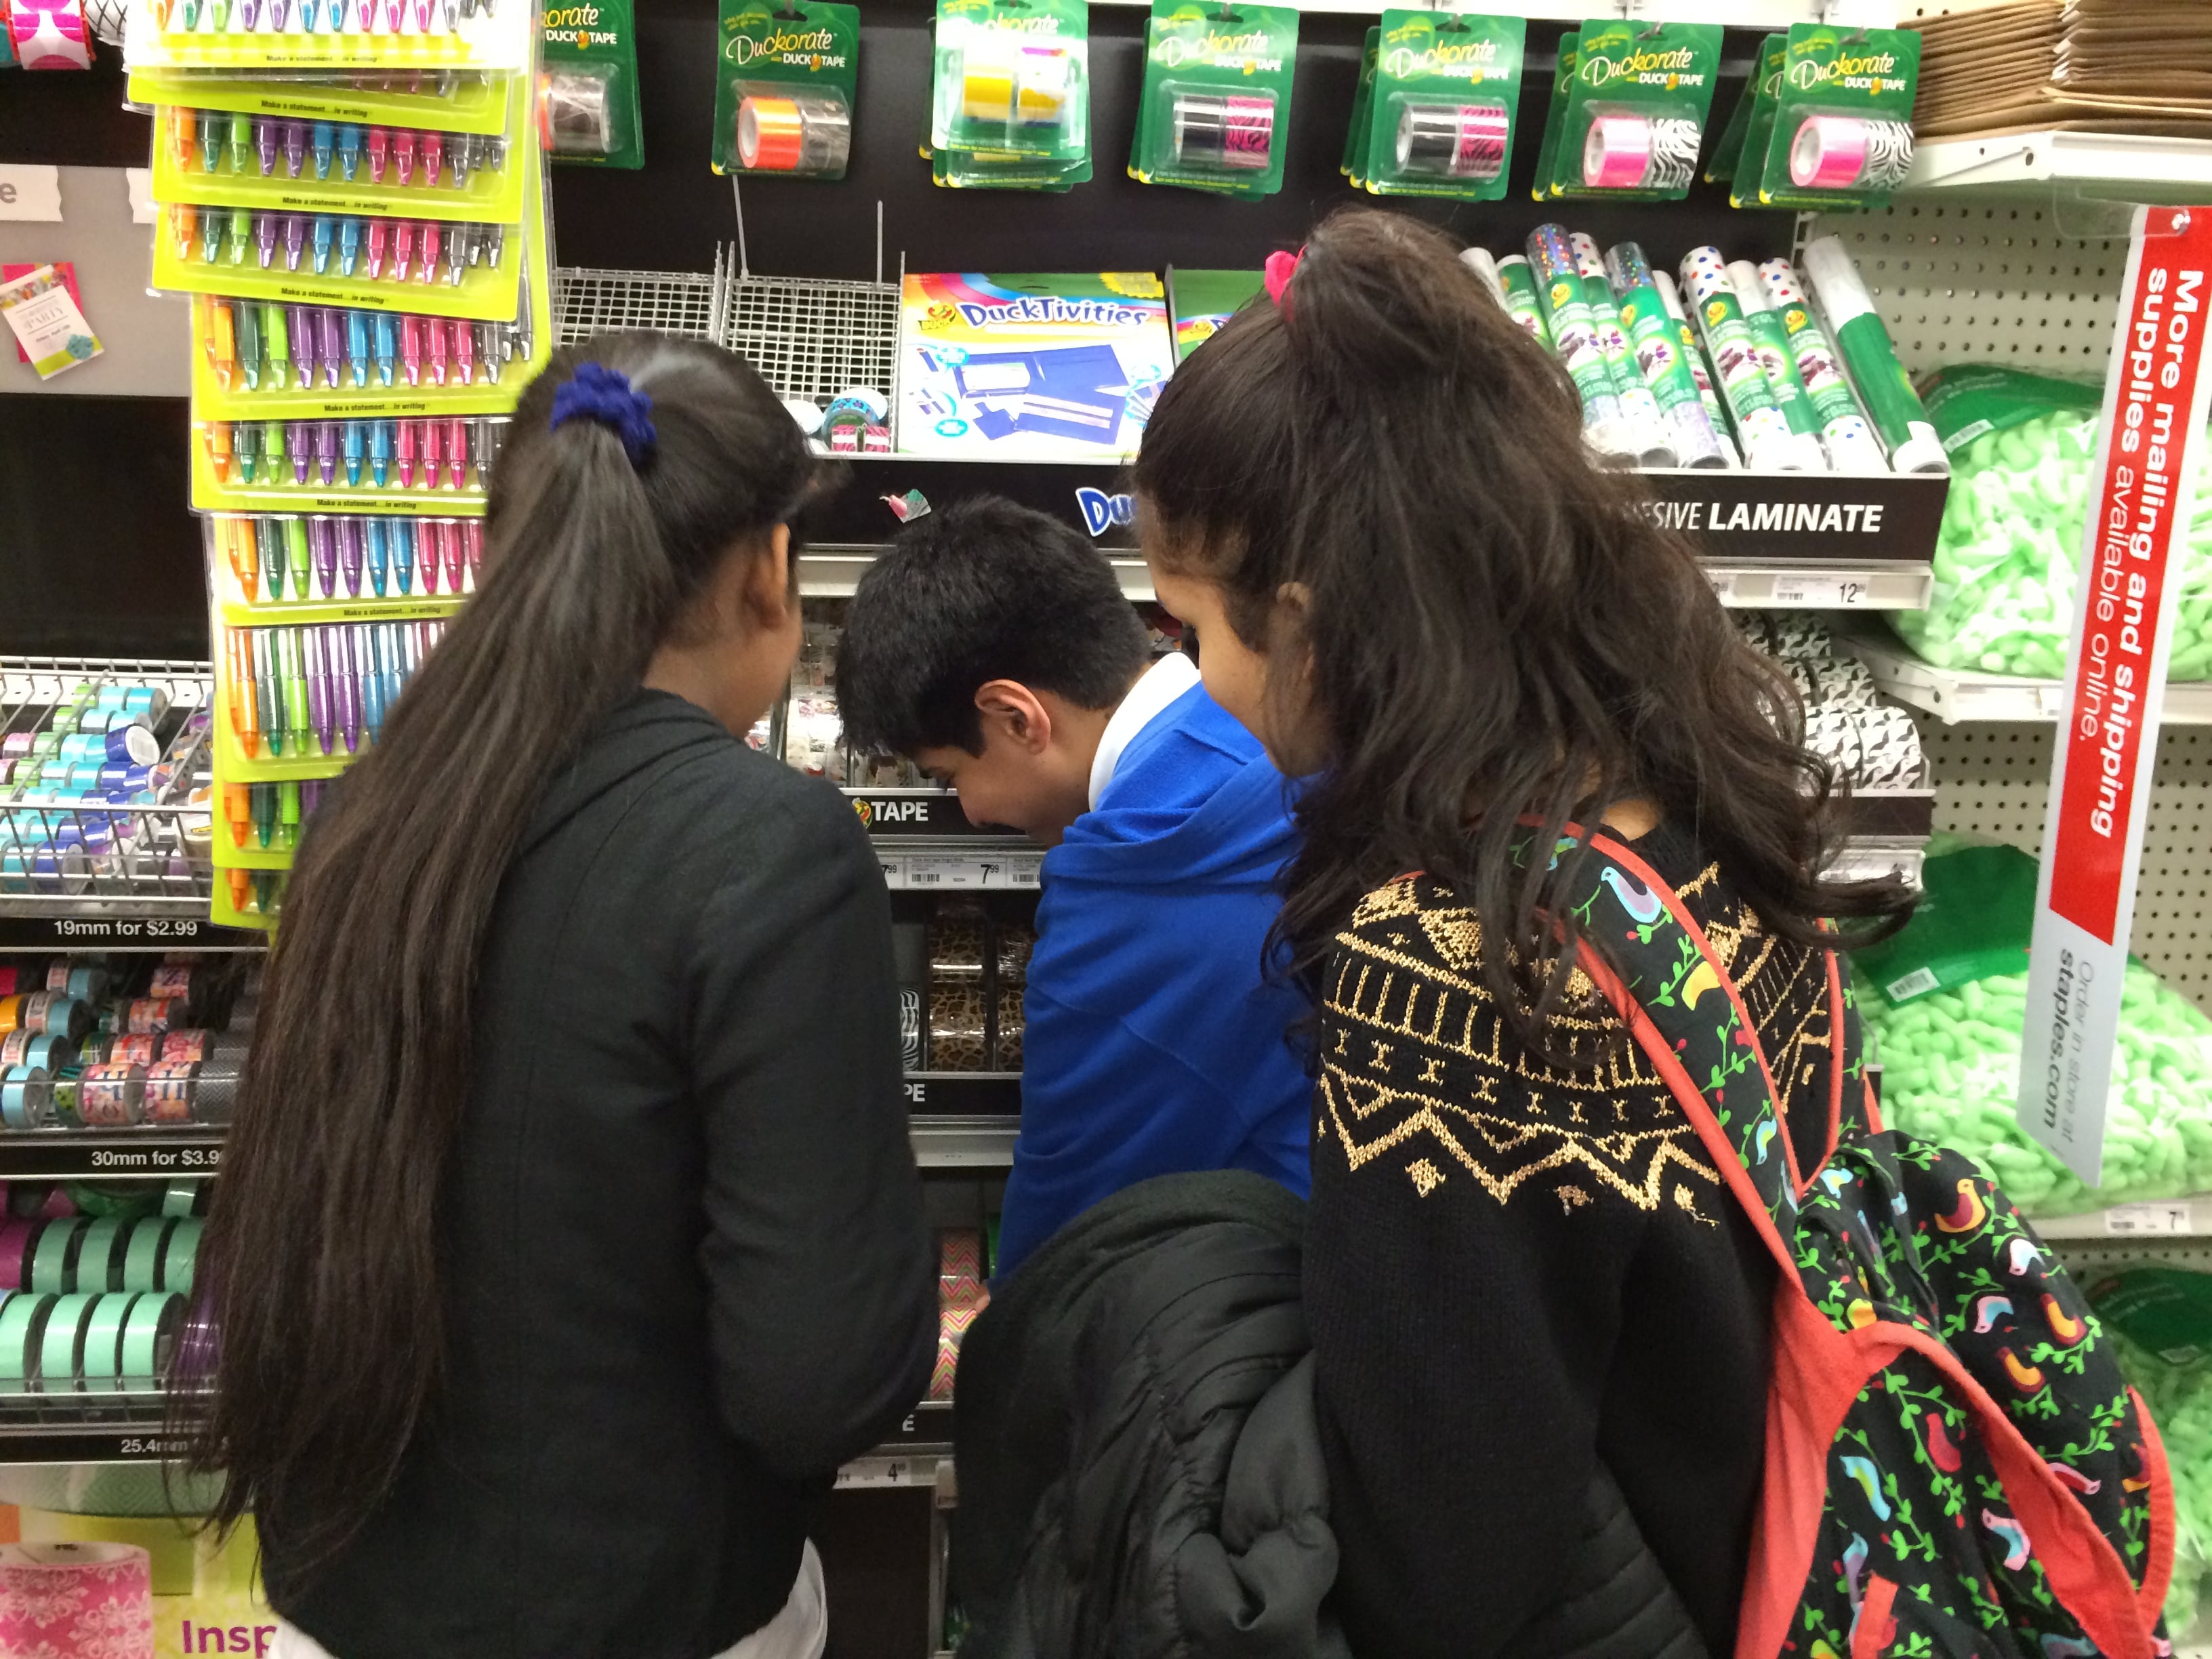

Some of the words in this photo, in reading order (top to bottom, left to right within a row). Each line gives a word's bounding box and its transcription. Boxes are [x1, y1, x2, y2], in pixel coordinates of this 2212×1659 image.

[546, 30, 578, 42] DUCK
[588, 32, 617, 44] TAPE
[726, 28, 832, 64] Duckorate
[783, 53, 811, 64] DUCK
[821, 56, 846, 67] TAPE
[1385, 39, 1496, 78] Duckorate
[1582, 47, 1693, 86] Duckorate
[1790, 52, 1895, 89] Duckorate
[1639, 73, 1668, 84] DUCK
[1678, 74, 1704, 86] TAPE
[1844, 77, 1872, 88] DUCK
[1881, 79, 1906, 91] TAPE
[2160, 270, 2204, 389] More
[2121, 268, 2167, 453] supplies
[2129, 403, 2175, 560] mailing
[1708, 502, 1884, 533] LAMINATE
[2096, 465, 2135, 622] available
[2119, 572, 2146, 655] and
[2079, 633, 2109, 741] online.
[2090, 663, 2136, 838] shipping
[871, 802, 928, 821] TAPE
[54, 920, 110, 935] 19mm
[115, 920, 142, 935] for
[146, 920, 198, 936] $2.99
[2075, 961, 2094, 1025] Order
[2044, 949, 2074, 1129] staples.com
[2072, 1031, 2084, 1052] in
[2064, 1057, 2081, 1114] store
[91, 1151, 147, 1166] 30mm
[152, 1151, 178, 1166] for
[182, 1149, 221, 1166] $3.9
